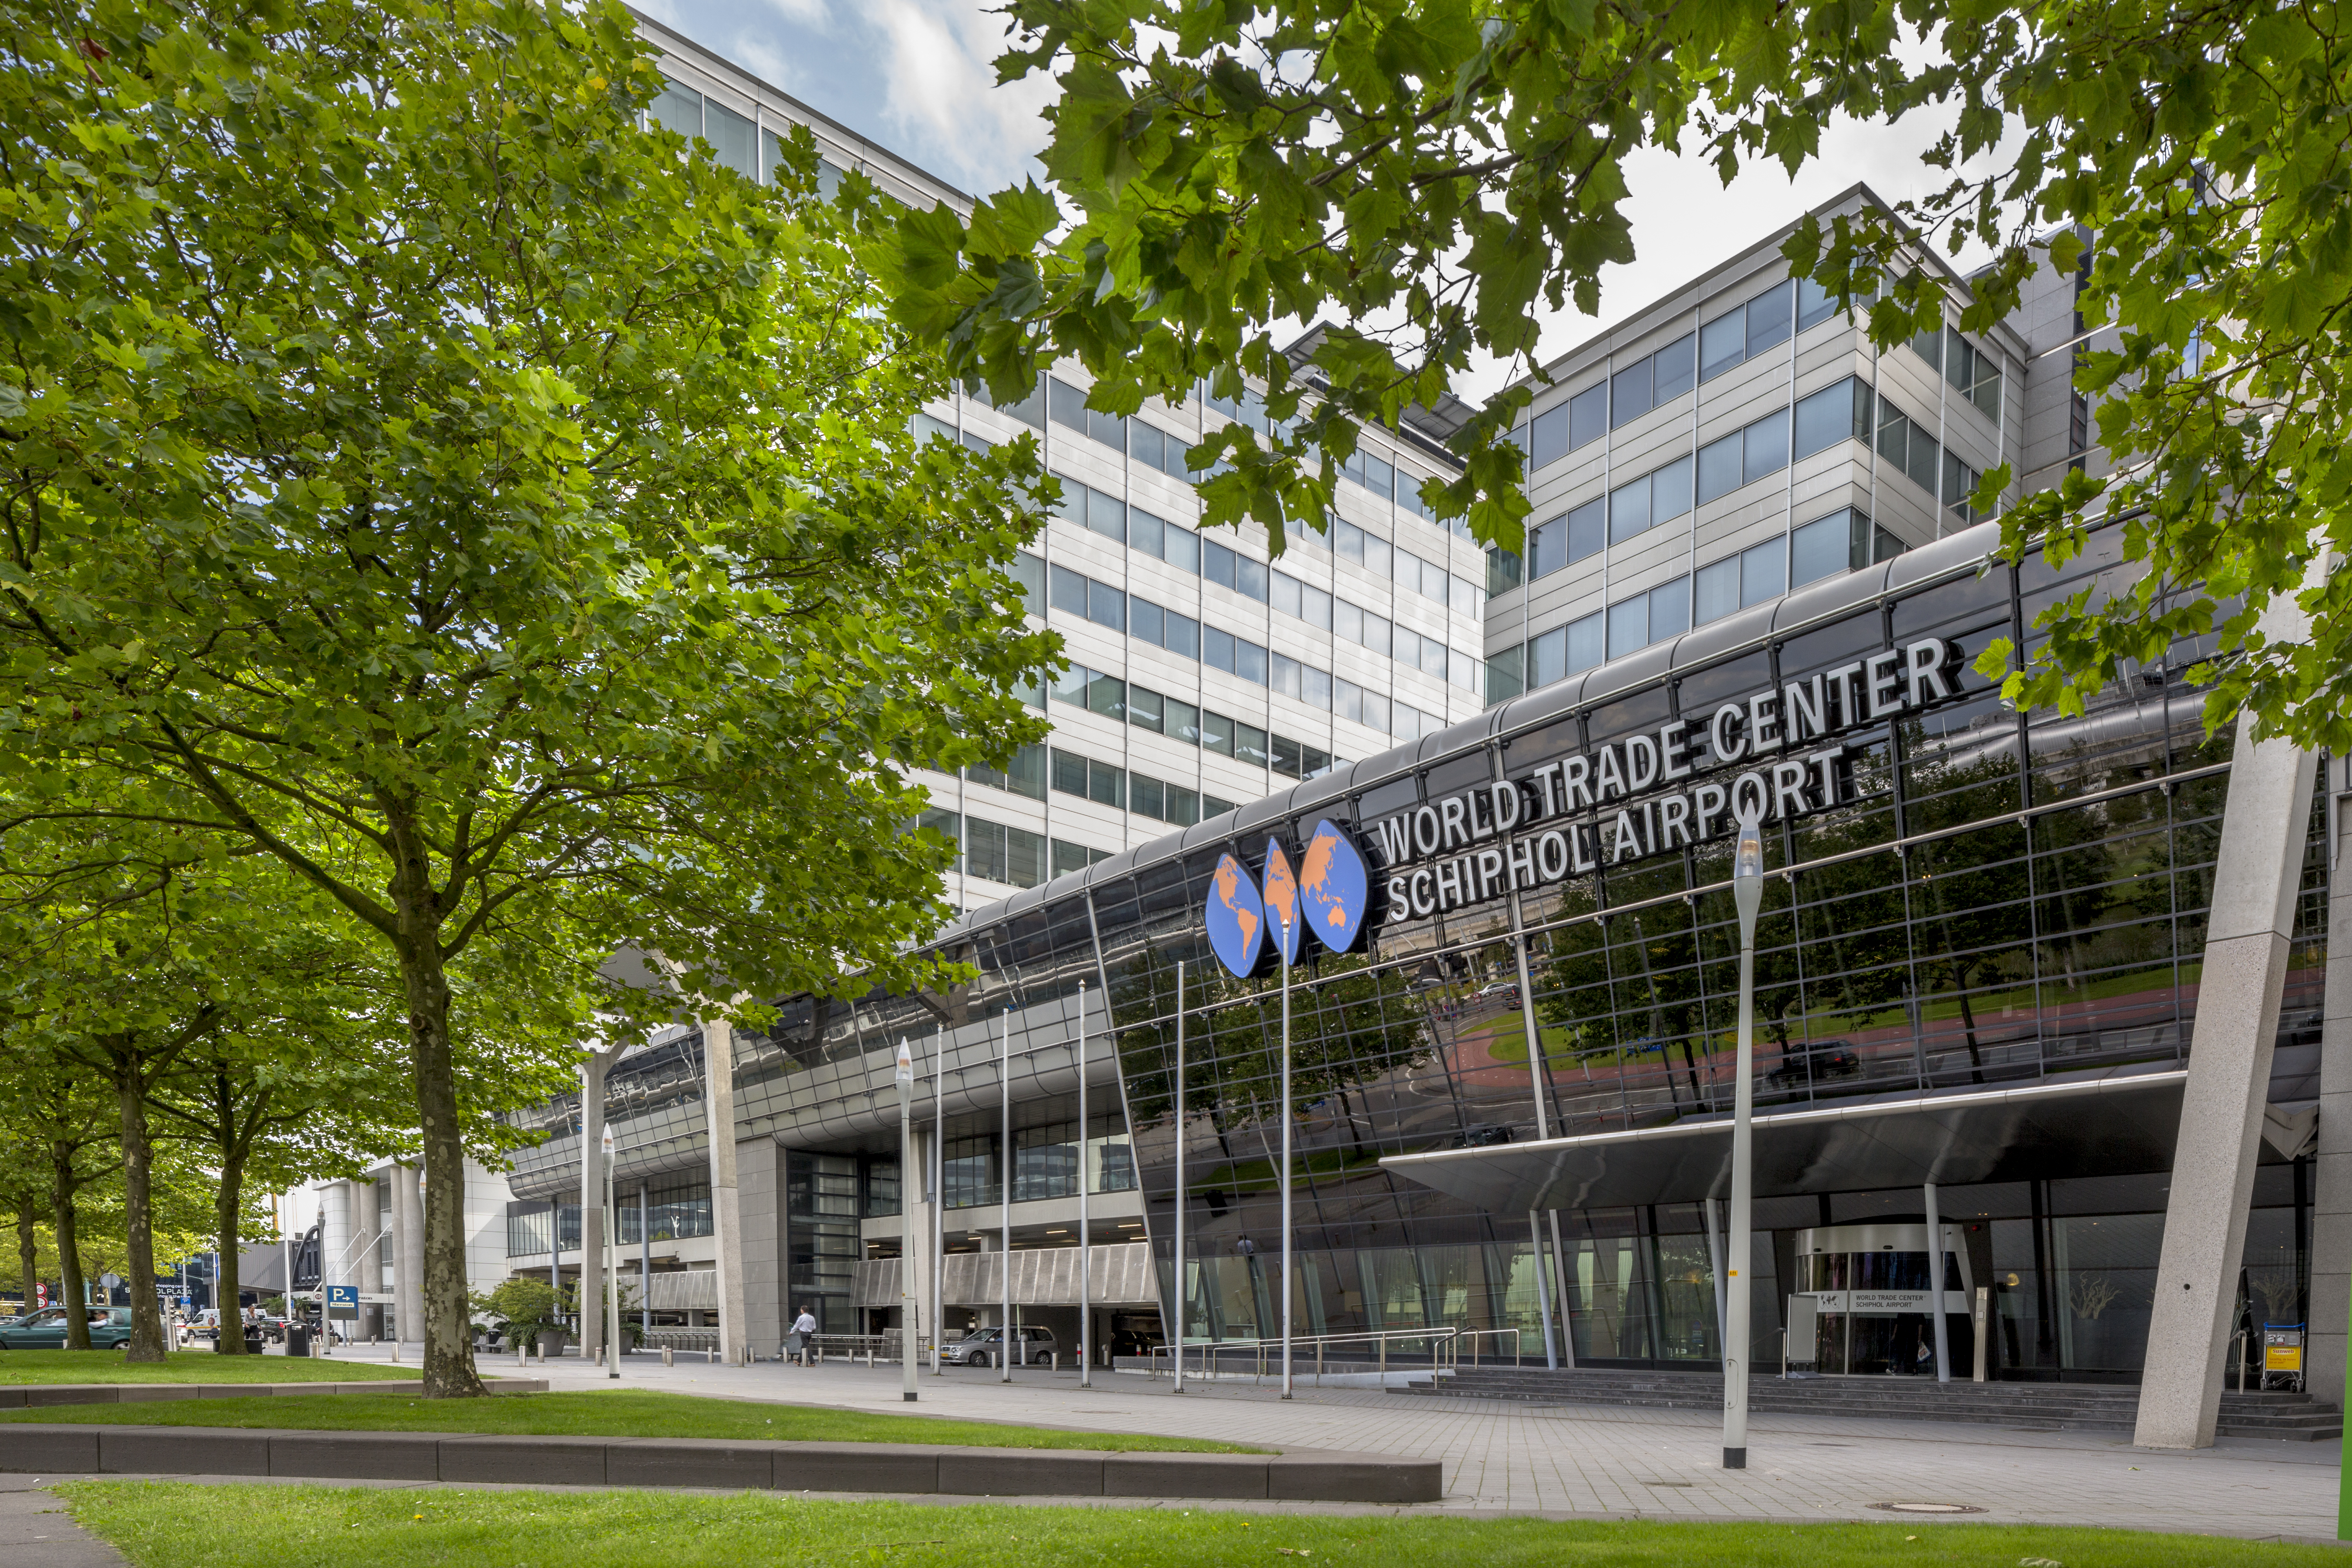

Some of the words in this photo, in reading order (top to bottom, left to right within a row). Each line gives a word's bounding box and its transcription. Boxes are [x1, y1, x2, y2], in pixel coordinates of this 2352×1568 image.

[1378, 780, 1521, 866] WORLD
[1534, 719, 1691, 816] TRADE
[1711, 637, 1952, 762] CENTER
[1388, 824, 1596, 922] SCHIPHOL
[1613, 747, 1843, 863] AIRPORT
[333, 1288, 344, 1301] P
